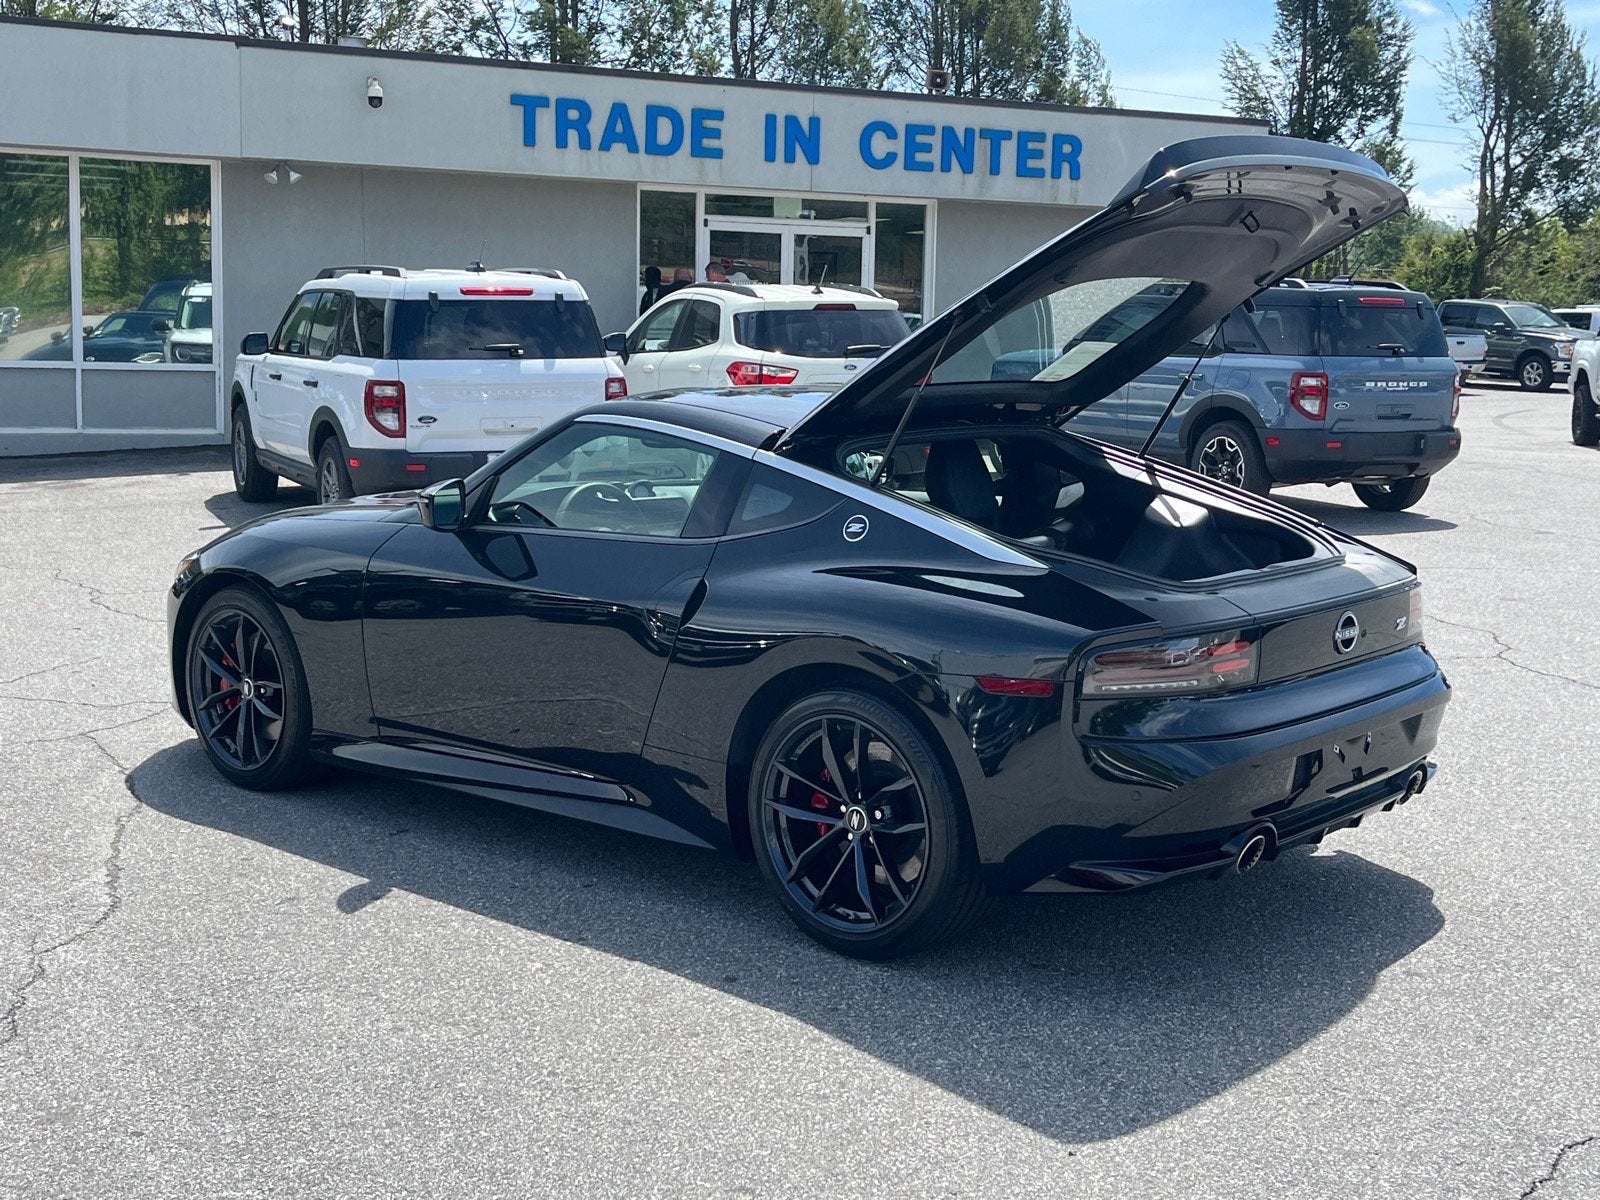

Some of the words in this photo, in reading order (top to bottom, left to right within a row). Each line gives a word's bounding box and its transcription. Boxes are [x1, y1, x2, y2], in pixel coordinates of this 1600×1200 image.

[510, 93, 725, 159] TRADE
[765, 113, 821, 165] IN
[859, 120, 1083, 181] CENTER
[1396, 616, 1407, 630] Z
[1335, 628, 1355, 639] NISS
